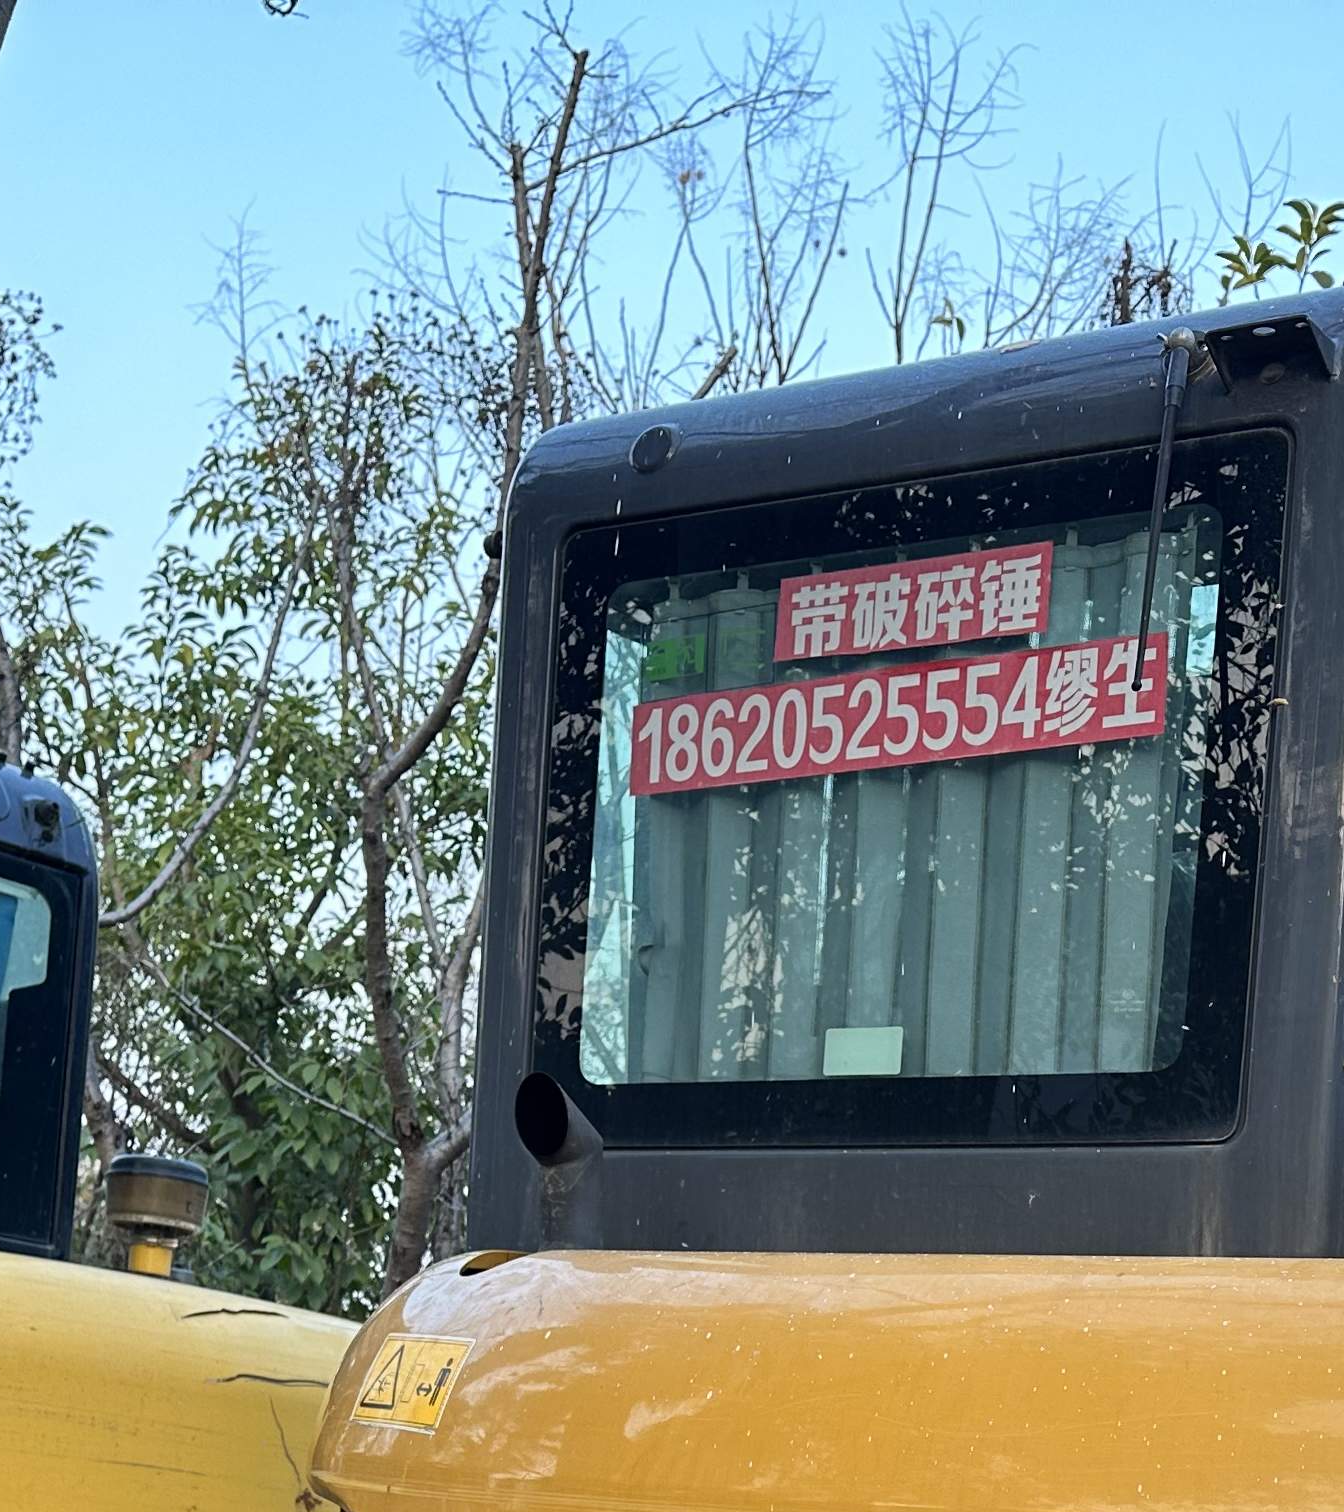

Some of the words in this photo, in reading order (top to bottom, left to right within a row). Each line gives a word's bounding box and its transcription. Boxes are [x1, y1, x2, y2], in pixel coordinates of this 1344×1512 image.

[791, 554, 1044, 658] 带破碎锤
[638, 640, 1156, 784] 18620525554缪生
